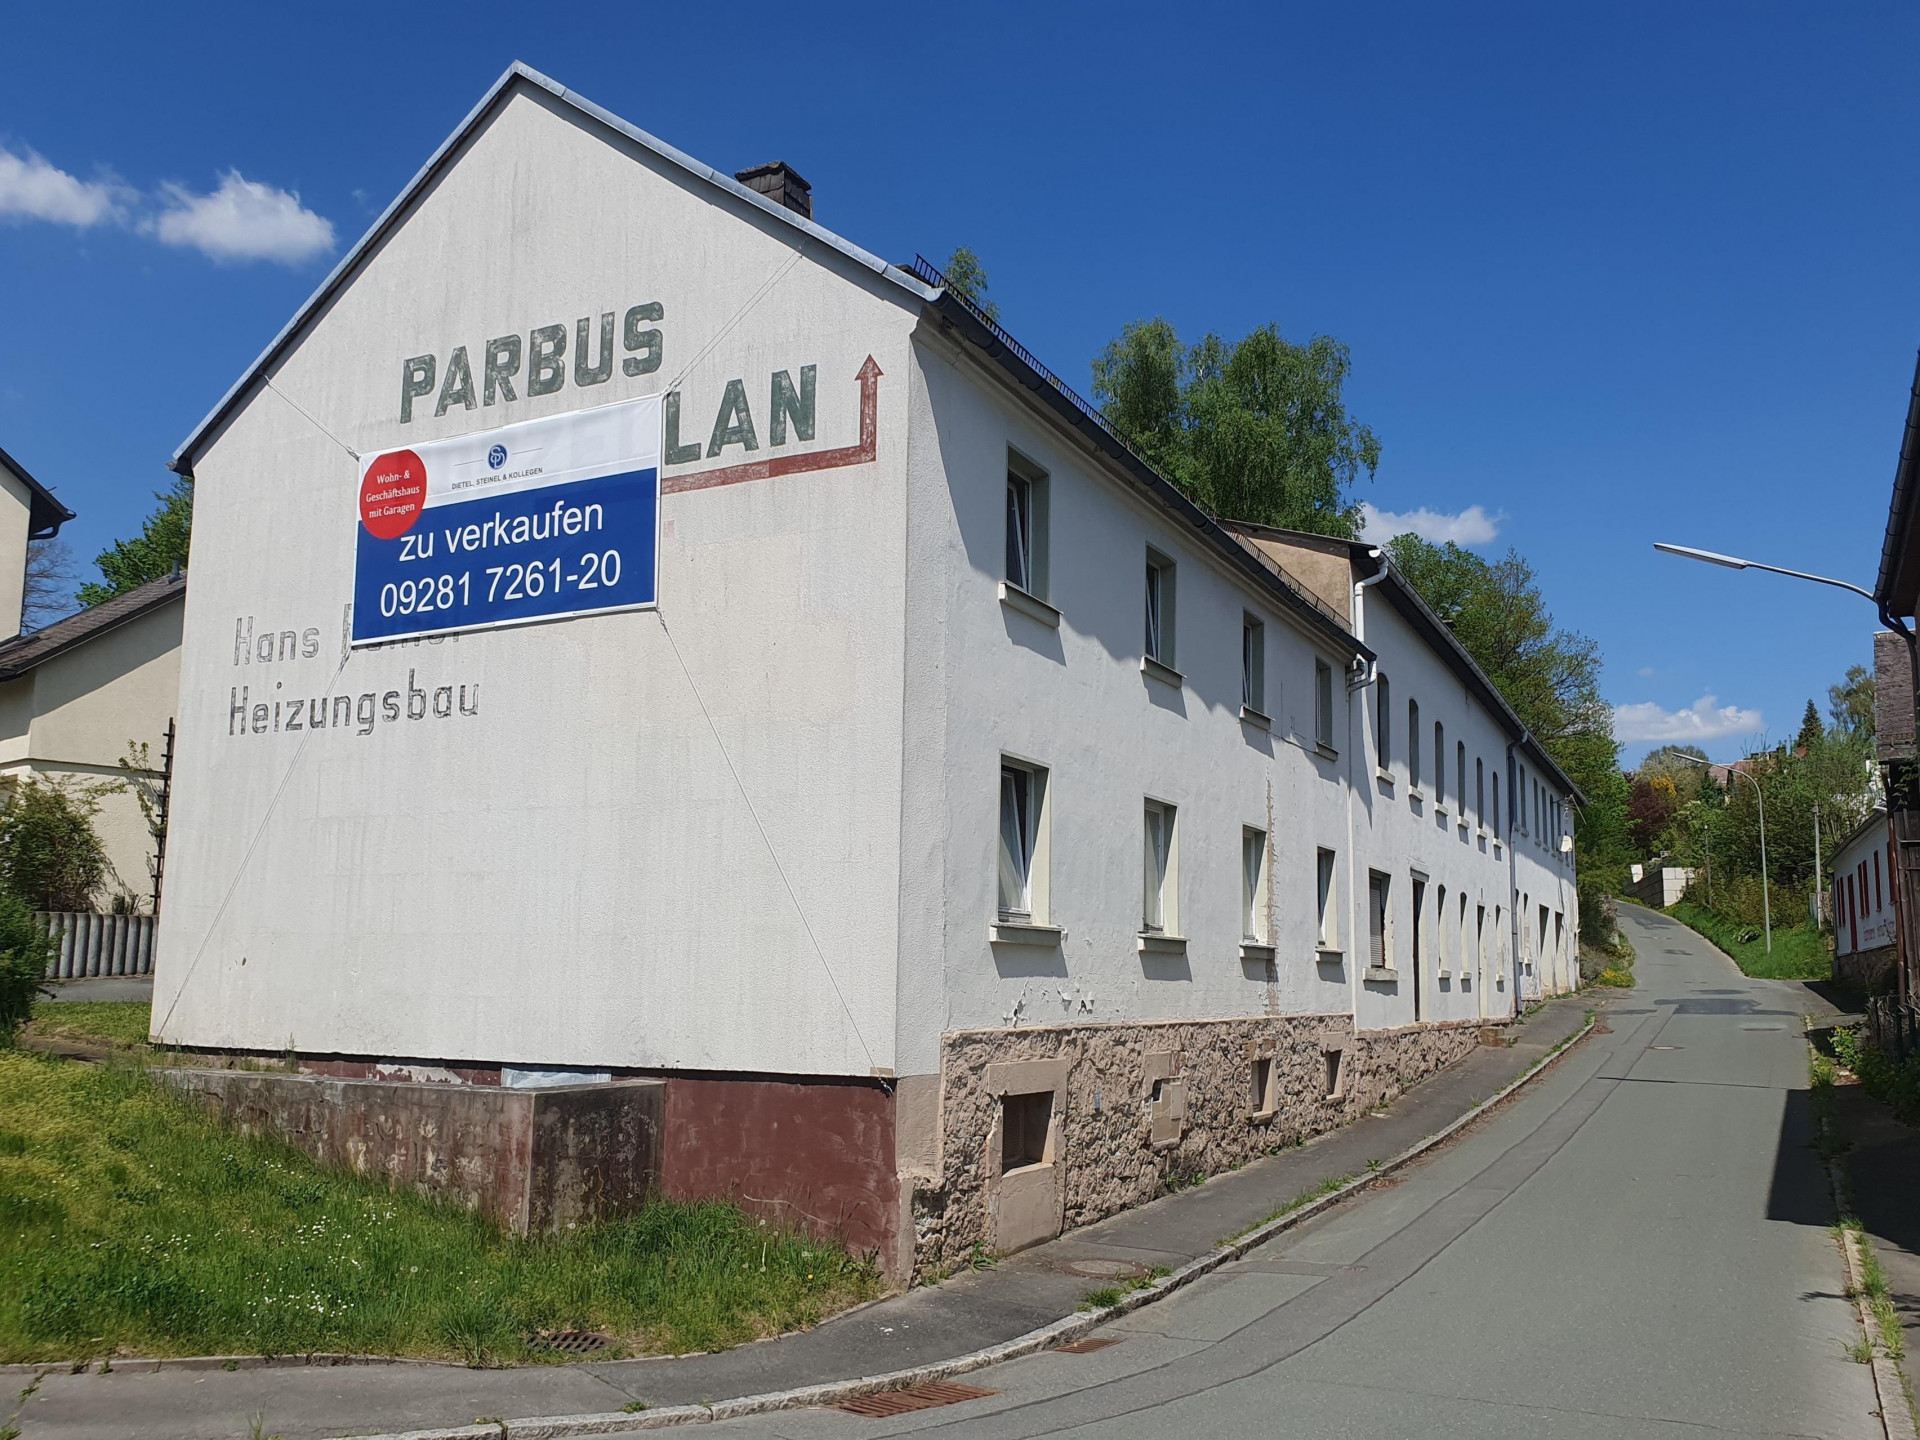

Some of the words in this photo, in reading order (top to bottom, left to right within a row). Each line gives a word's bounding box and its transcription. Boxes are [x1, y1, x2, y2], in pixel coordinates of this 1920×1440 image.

[400, 301, 665, 424] PARBUS
[365, 485, 421, 503] Geschäftshaus
[376, 470, 402, 485] Wohn-
[403, 469, 411, 479] &
[451, 480, 474, 490] DIETEL,
[475, 473, 501, 486] STEINEL
[508, 466, 543, 480] KOLLEGEN
[368, 506, 382, 519] mit
[383, 502, 415, 517] Garagen
[399, 531, 434, 562] zu
[444, 500, 604, 555] verkaufen
[379, 571, 472, 618] 09281
[485, 549, 621, 603] 7261-20
[233, 615, 320, 666] Hans
[229, 667, 479, 737] Heizungsbau
